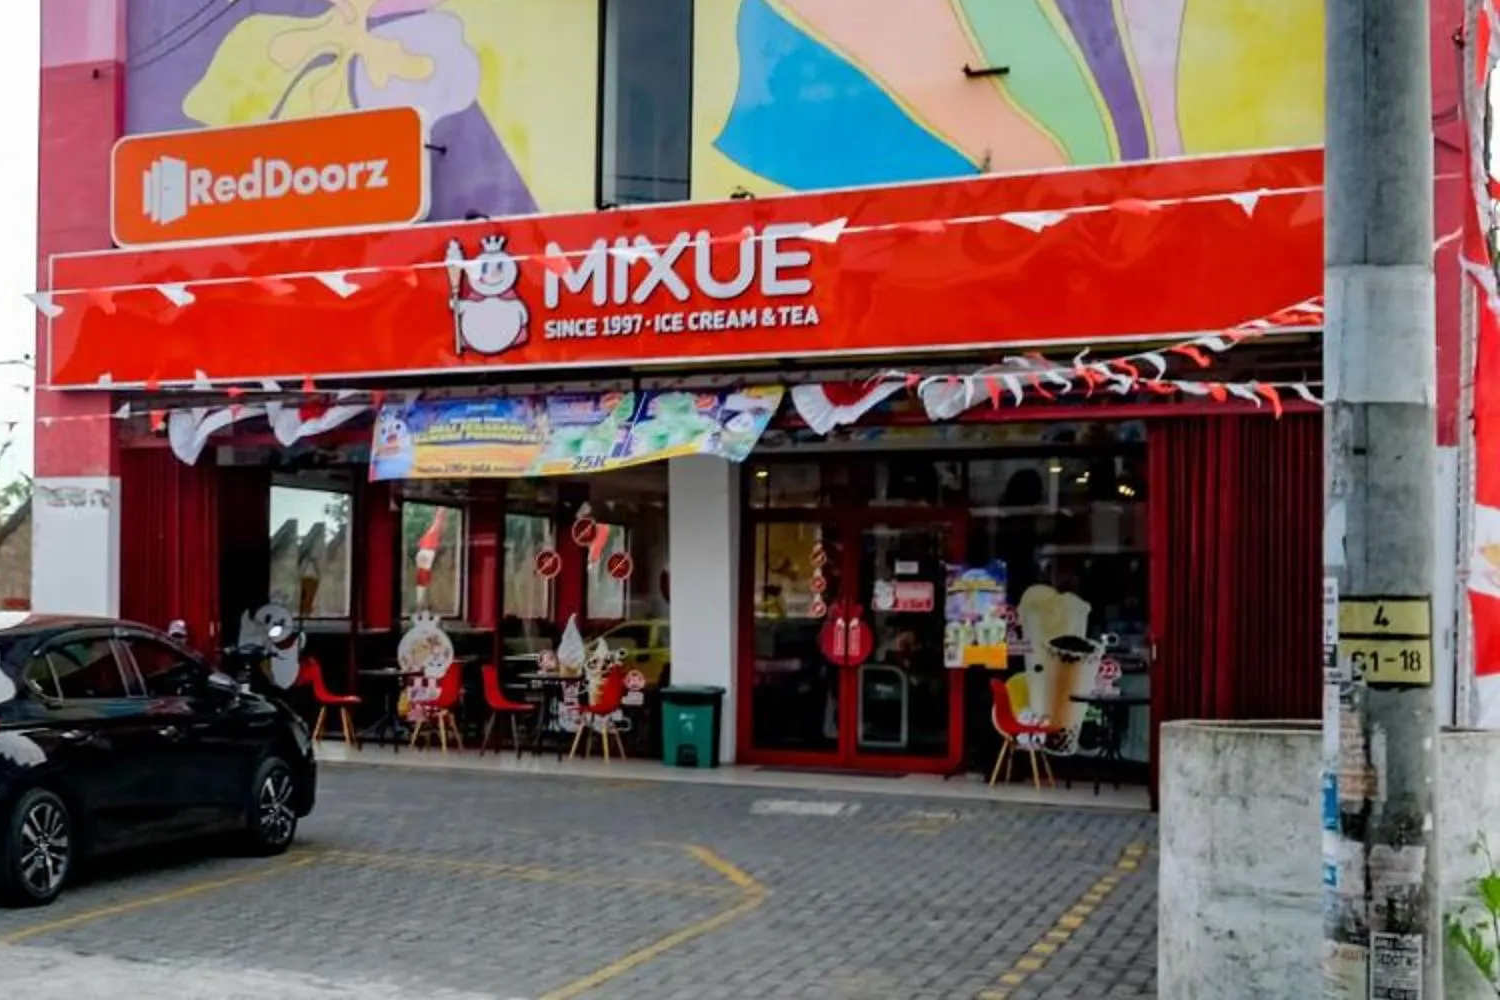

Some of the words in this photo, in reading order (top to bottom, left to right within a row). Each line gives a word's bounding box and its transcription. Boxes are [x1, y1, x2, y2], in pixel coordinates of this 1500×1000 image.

[189, 156, 389, 207] RedDoorz
[544, 222, 813, 309] MIXUE
[544, 318, 598, 339] SINCE
[601, 314, 644, 335] 1997
[654, 312, 686, 332] ICE
[688, 310, 758, 330] CREAM
[760, 309, 776, 326] &
[777, 306, 820, 325] TEA
[1373, 605, 1389, 626] 4
